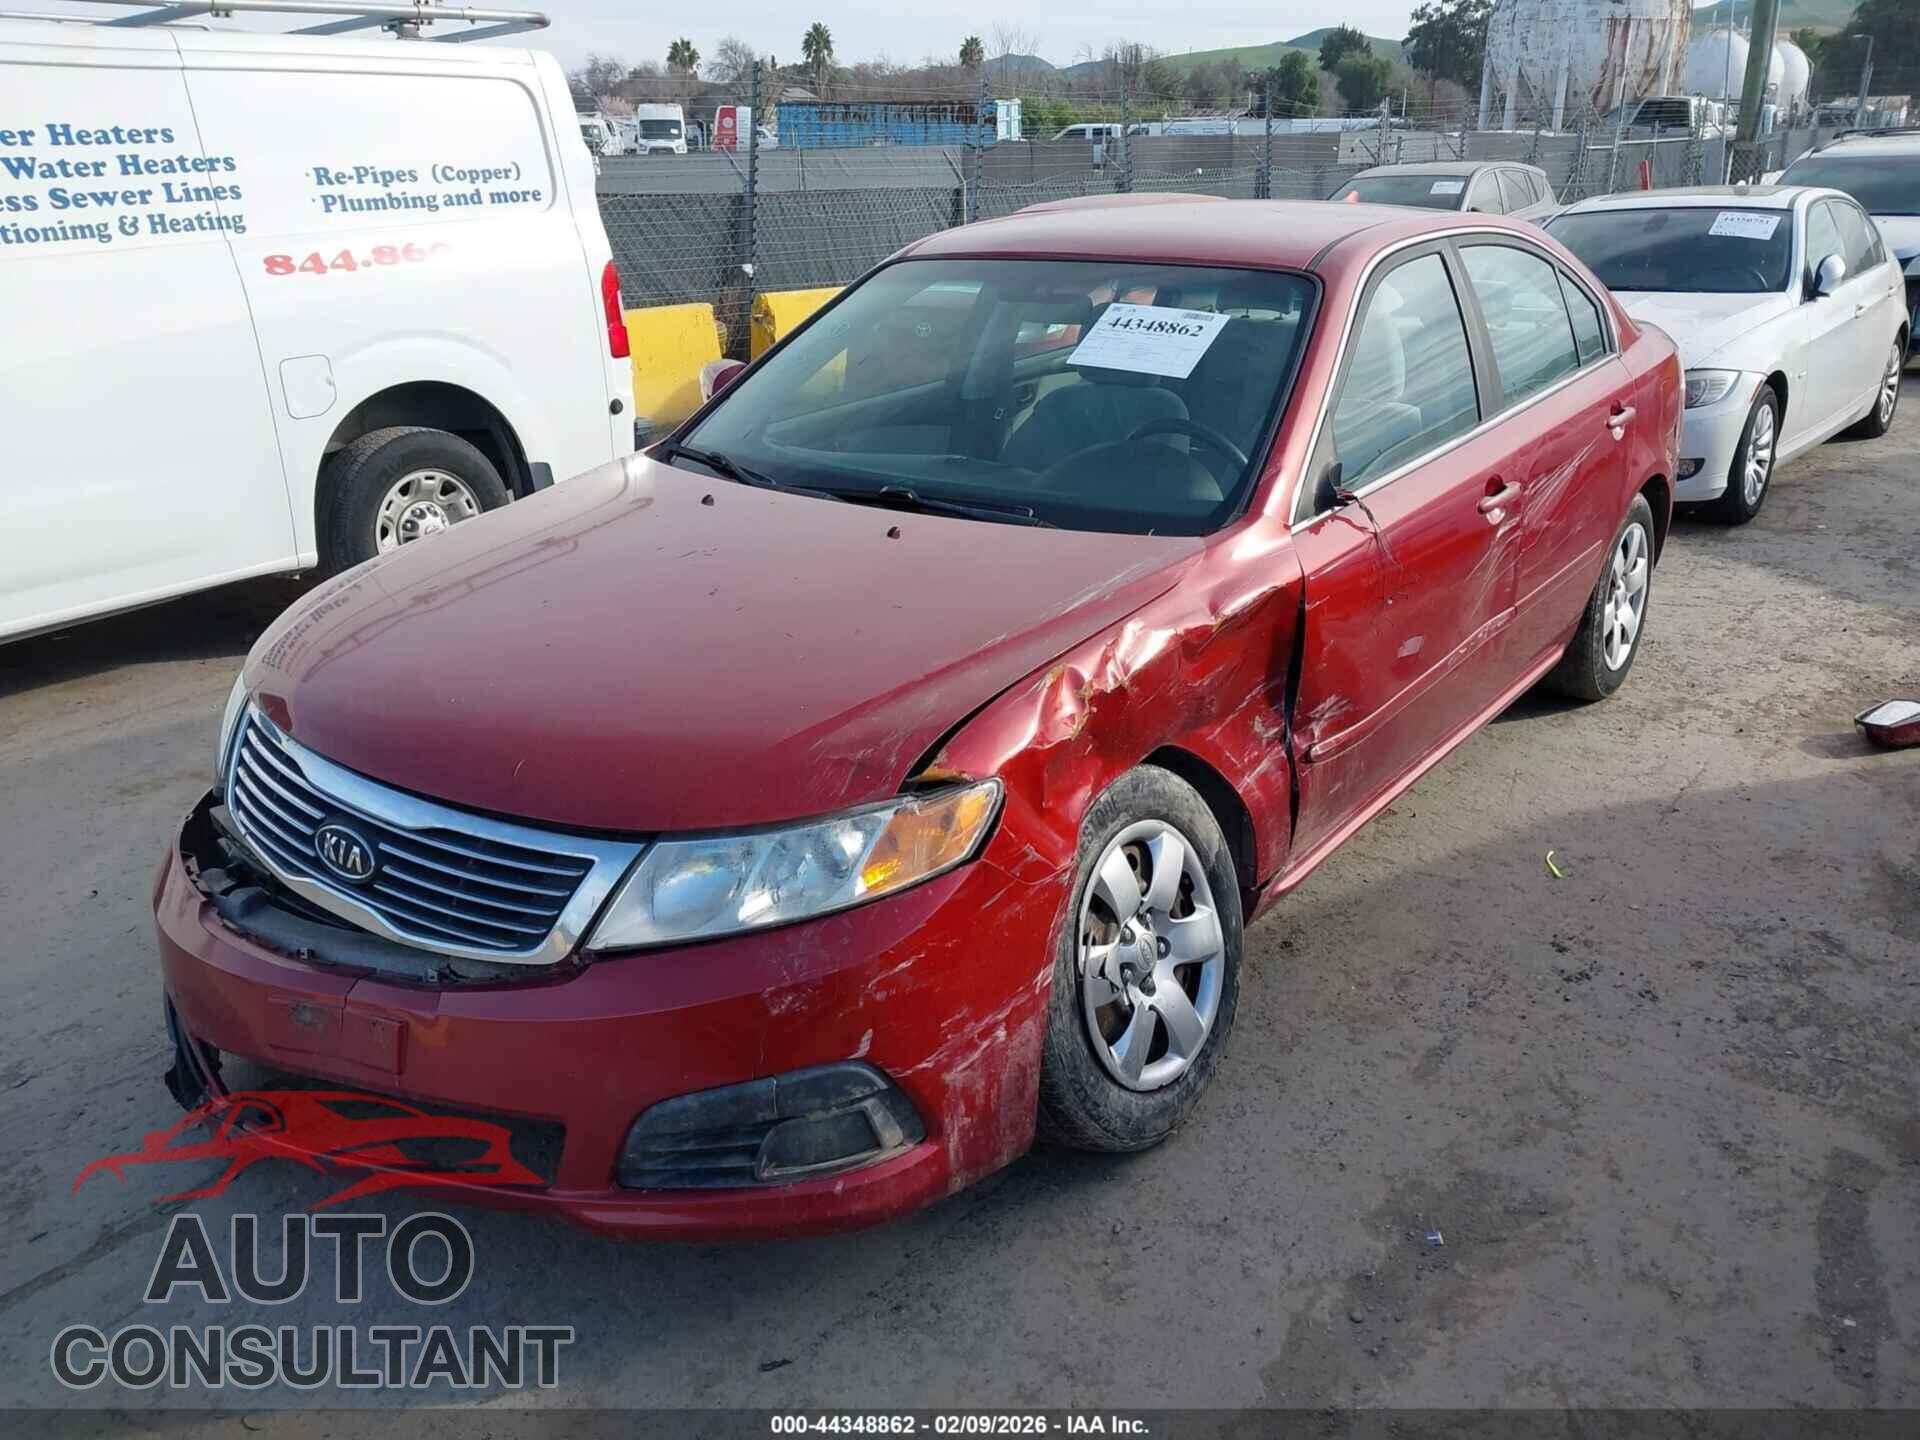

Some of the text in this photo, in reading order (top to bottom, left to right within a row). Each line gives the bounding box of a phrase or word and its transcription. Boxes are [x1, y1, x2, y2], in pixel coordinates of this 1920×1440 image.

[0, 123, 175, 146] er Heaters
[0, 153, 237, 180] Water Heaters
[312, 161, 521, 187] Re-Pipes (Copper)
[48, 187, 153, 209] Sewer
[161, 182, 242, 203] Lines
[320, 188, 542, 213] Plumbing and more
[118, 214, 139, 236] &
[147, 210, 247, 235] Heating
[263, 241, 451, 276] 844.86
[1108, 316, 1204, 337] 44348862
